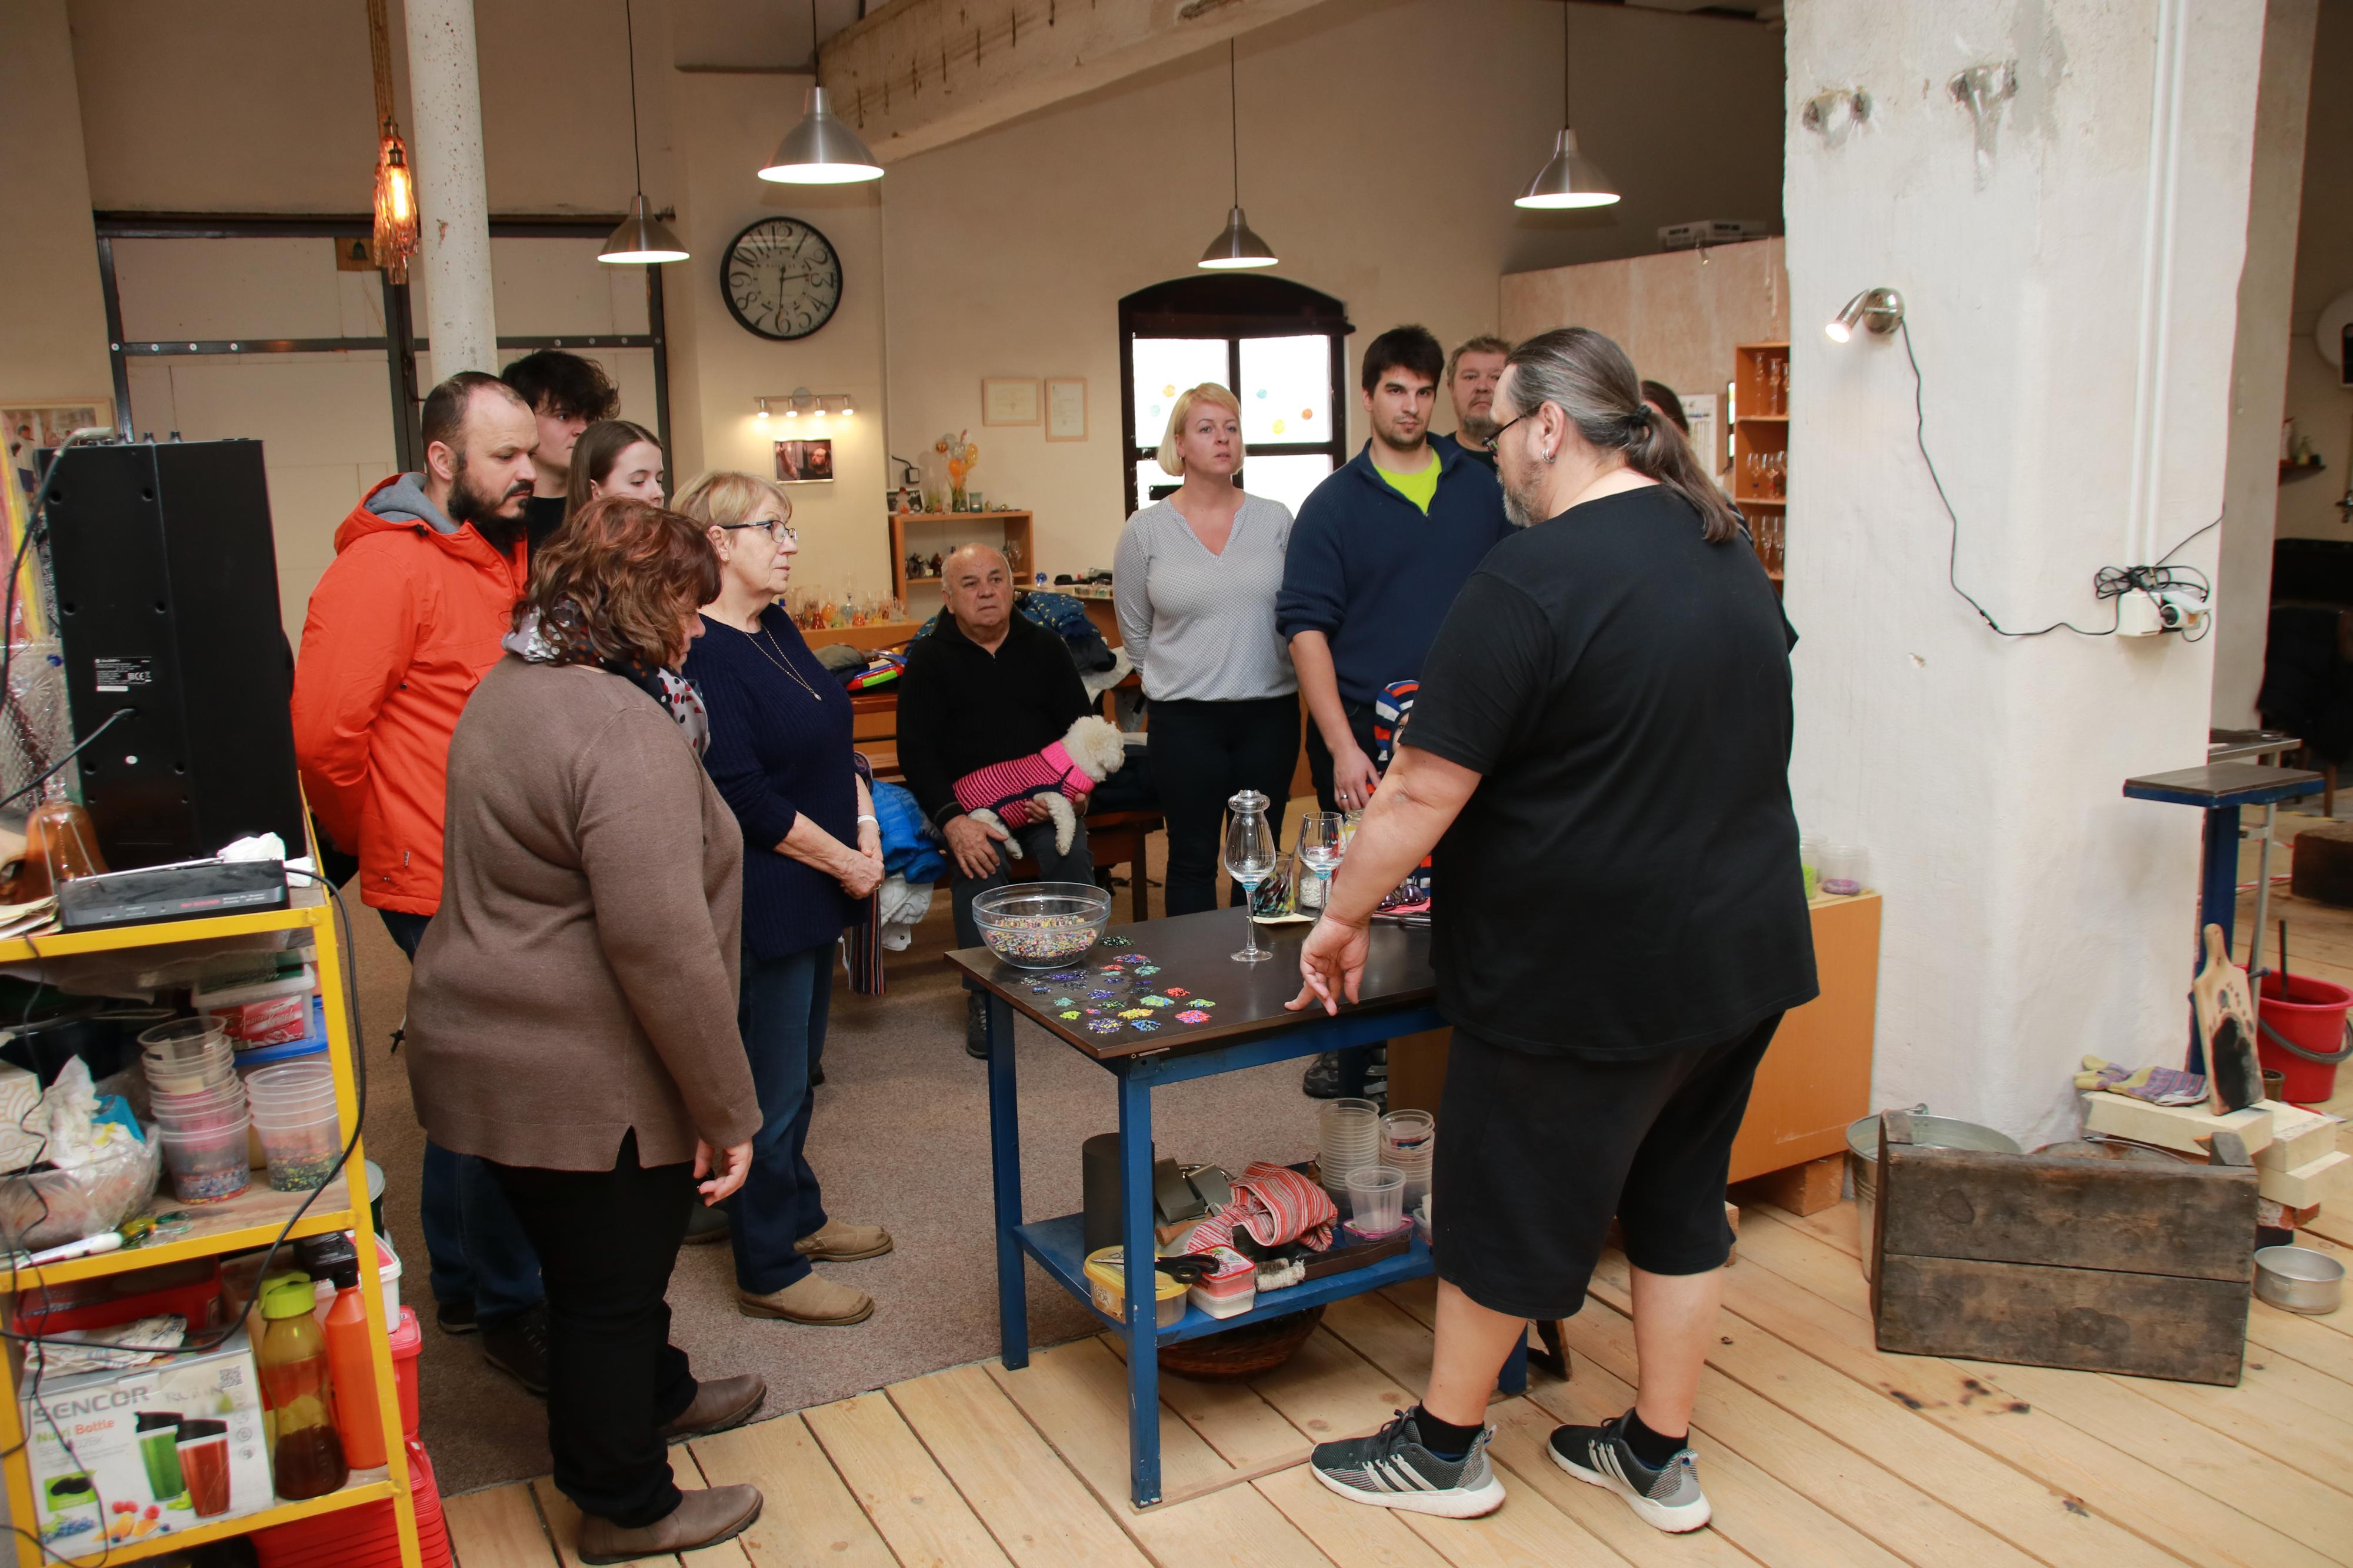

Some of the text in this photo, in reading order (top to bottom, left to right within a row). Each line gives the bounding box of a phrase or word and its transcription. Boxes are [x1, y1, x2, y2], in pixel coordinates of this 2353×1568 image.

[771, 225, 793, 249] 12
[792, 229, 811, 259] 1
[733, 246, 758, 269] 10
[804, 248, 828, 272] 2
[729, 271, 752, 288] 9
[811, 272, 834, 289] 3
[736, 291, 758, 310] 8
[805, 293, 828, 312] 4
[754, 303, 773, 326] 7
[775, 308, 791, 333] 6
[794, 303, 812, 329] 5
[34, 1385, 149, 1424] SENCOR
[75, 1419, 114, 1435] Bottle
